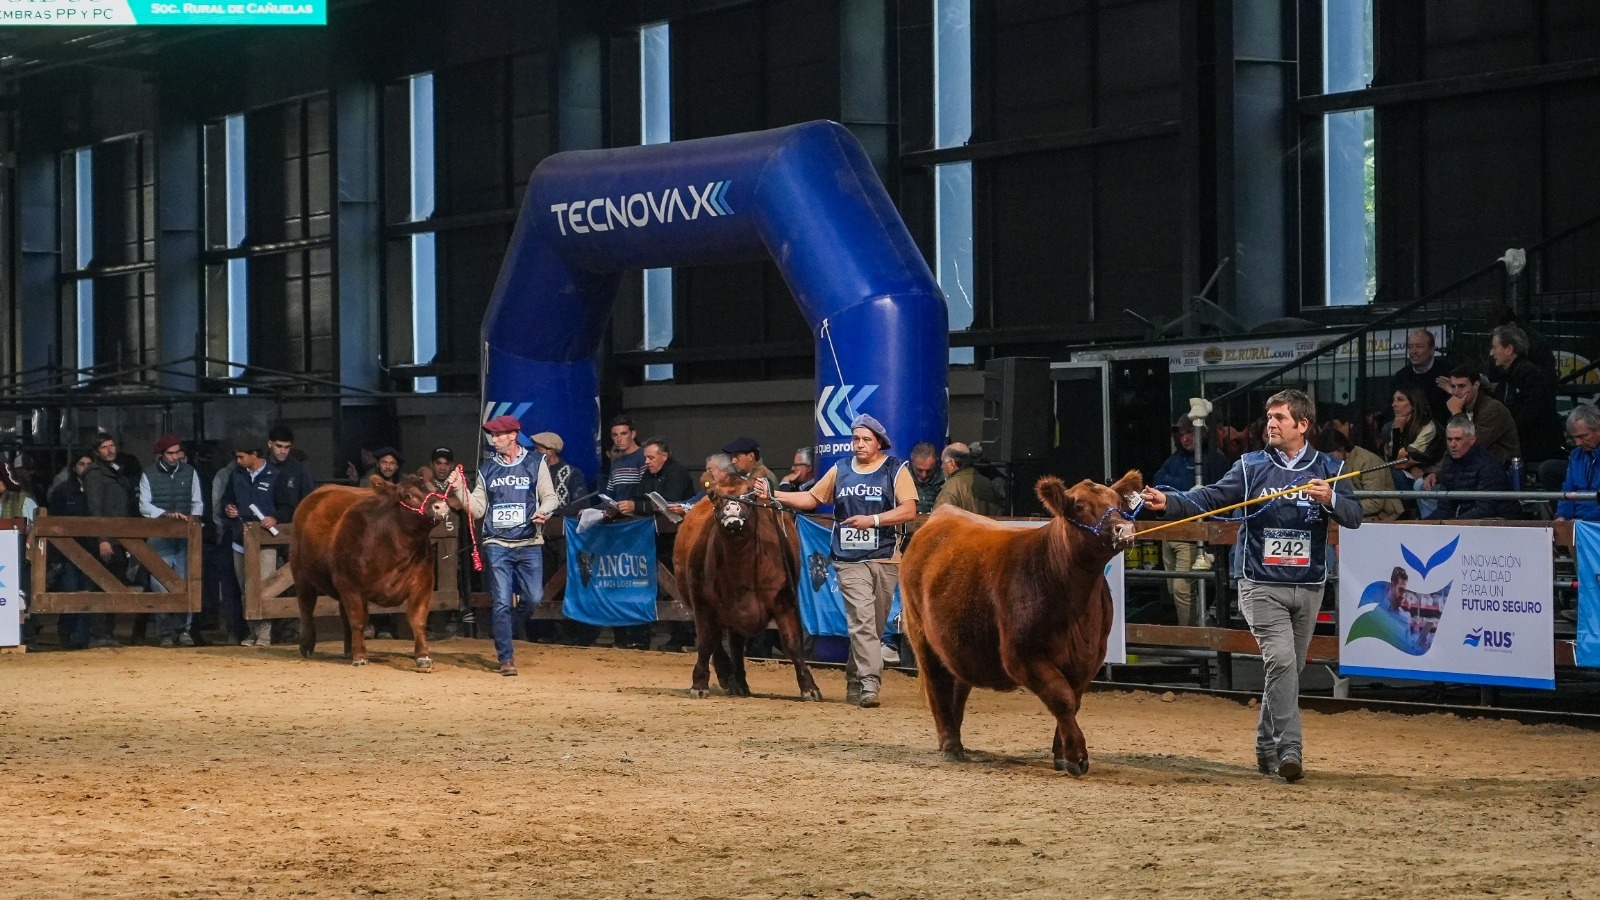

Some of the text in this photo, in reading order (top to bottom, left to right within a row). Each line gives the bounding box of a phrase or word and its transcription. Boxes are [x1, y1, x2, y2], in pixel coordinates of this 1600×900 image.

[0, 10, 52, 19] MBRAS
[56, 8, 76, 19] PP
[93, 8, 114, 20] PC
[183, 4, 226, 14] RURAL
[228, 4, 245, 14] DE
[246, 1, 314, 14] CAÑUELAS
[550, 182, 718, 236] TECNOVAX
[819, 444, 831, 455] que
[490, 475, 530, 488] ANGUS
[838, 483, 883, 497] ANGUS
[1259, 484, 1315, 501] ANGU
[845, 529, 871, 542] 248
[1271, 541, 1304, 556] 242
[596, 552, 648, 577] ANGUS
[1461, 553, 1521, 568] INNOVACIÓN
[1461, 569, 1512, 583] Y CALIDAD
[1461, 583, 1504, 597] PARA UN
[1461, 599, 1542, 613] FUTURO SEGURO
